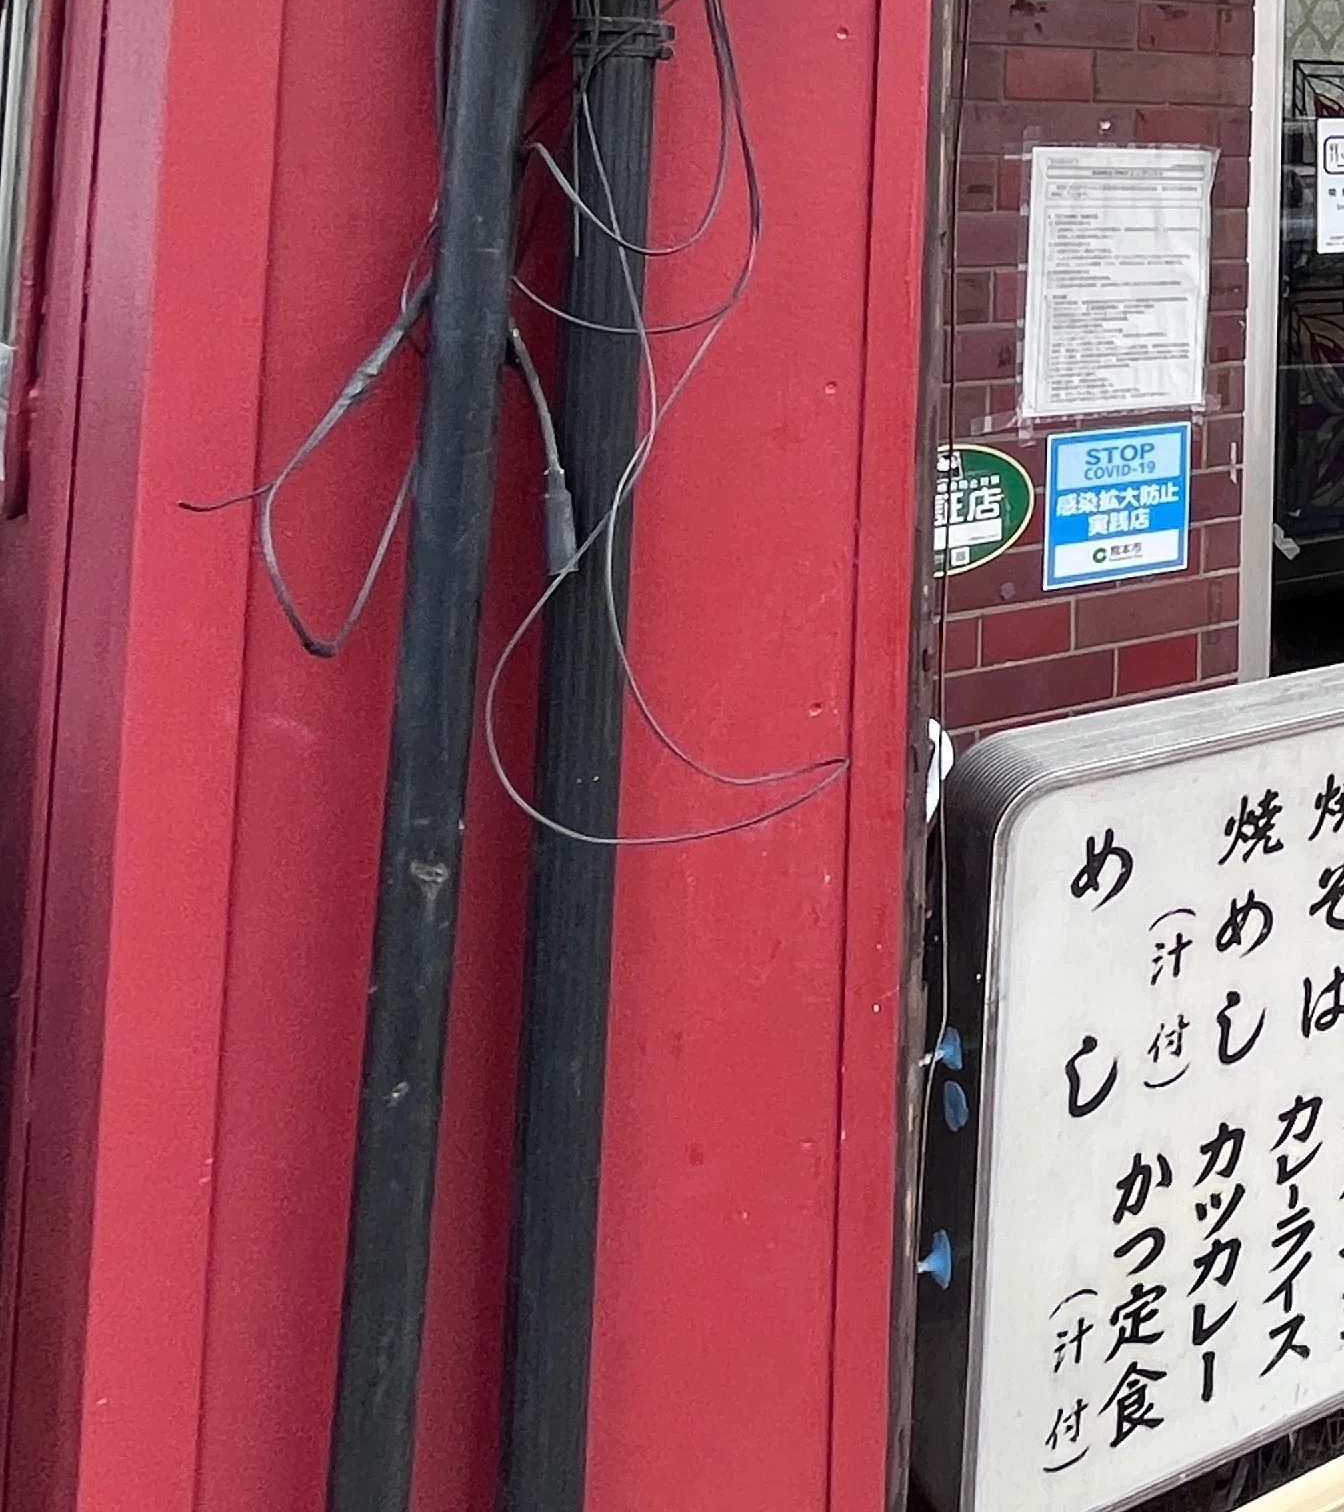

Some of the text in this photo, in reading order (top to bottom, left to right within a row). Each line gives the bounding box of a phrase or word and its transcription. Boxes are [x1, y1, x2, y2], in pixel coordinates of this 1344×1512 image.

[1084, 442, 1156, 466] STOP
[1084, 460, 1157, 481] COVID-19
[1056, 481, 1181, 517] 感染拡大防止
[1087, 507, 1151, 537] 実践店
[1260, 1094, 1323, 1377] カレーライス
[1187, 1122, 1246, 1404] カツカレー
[1098, 1152, 1174, 1448] かつ定食
